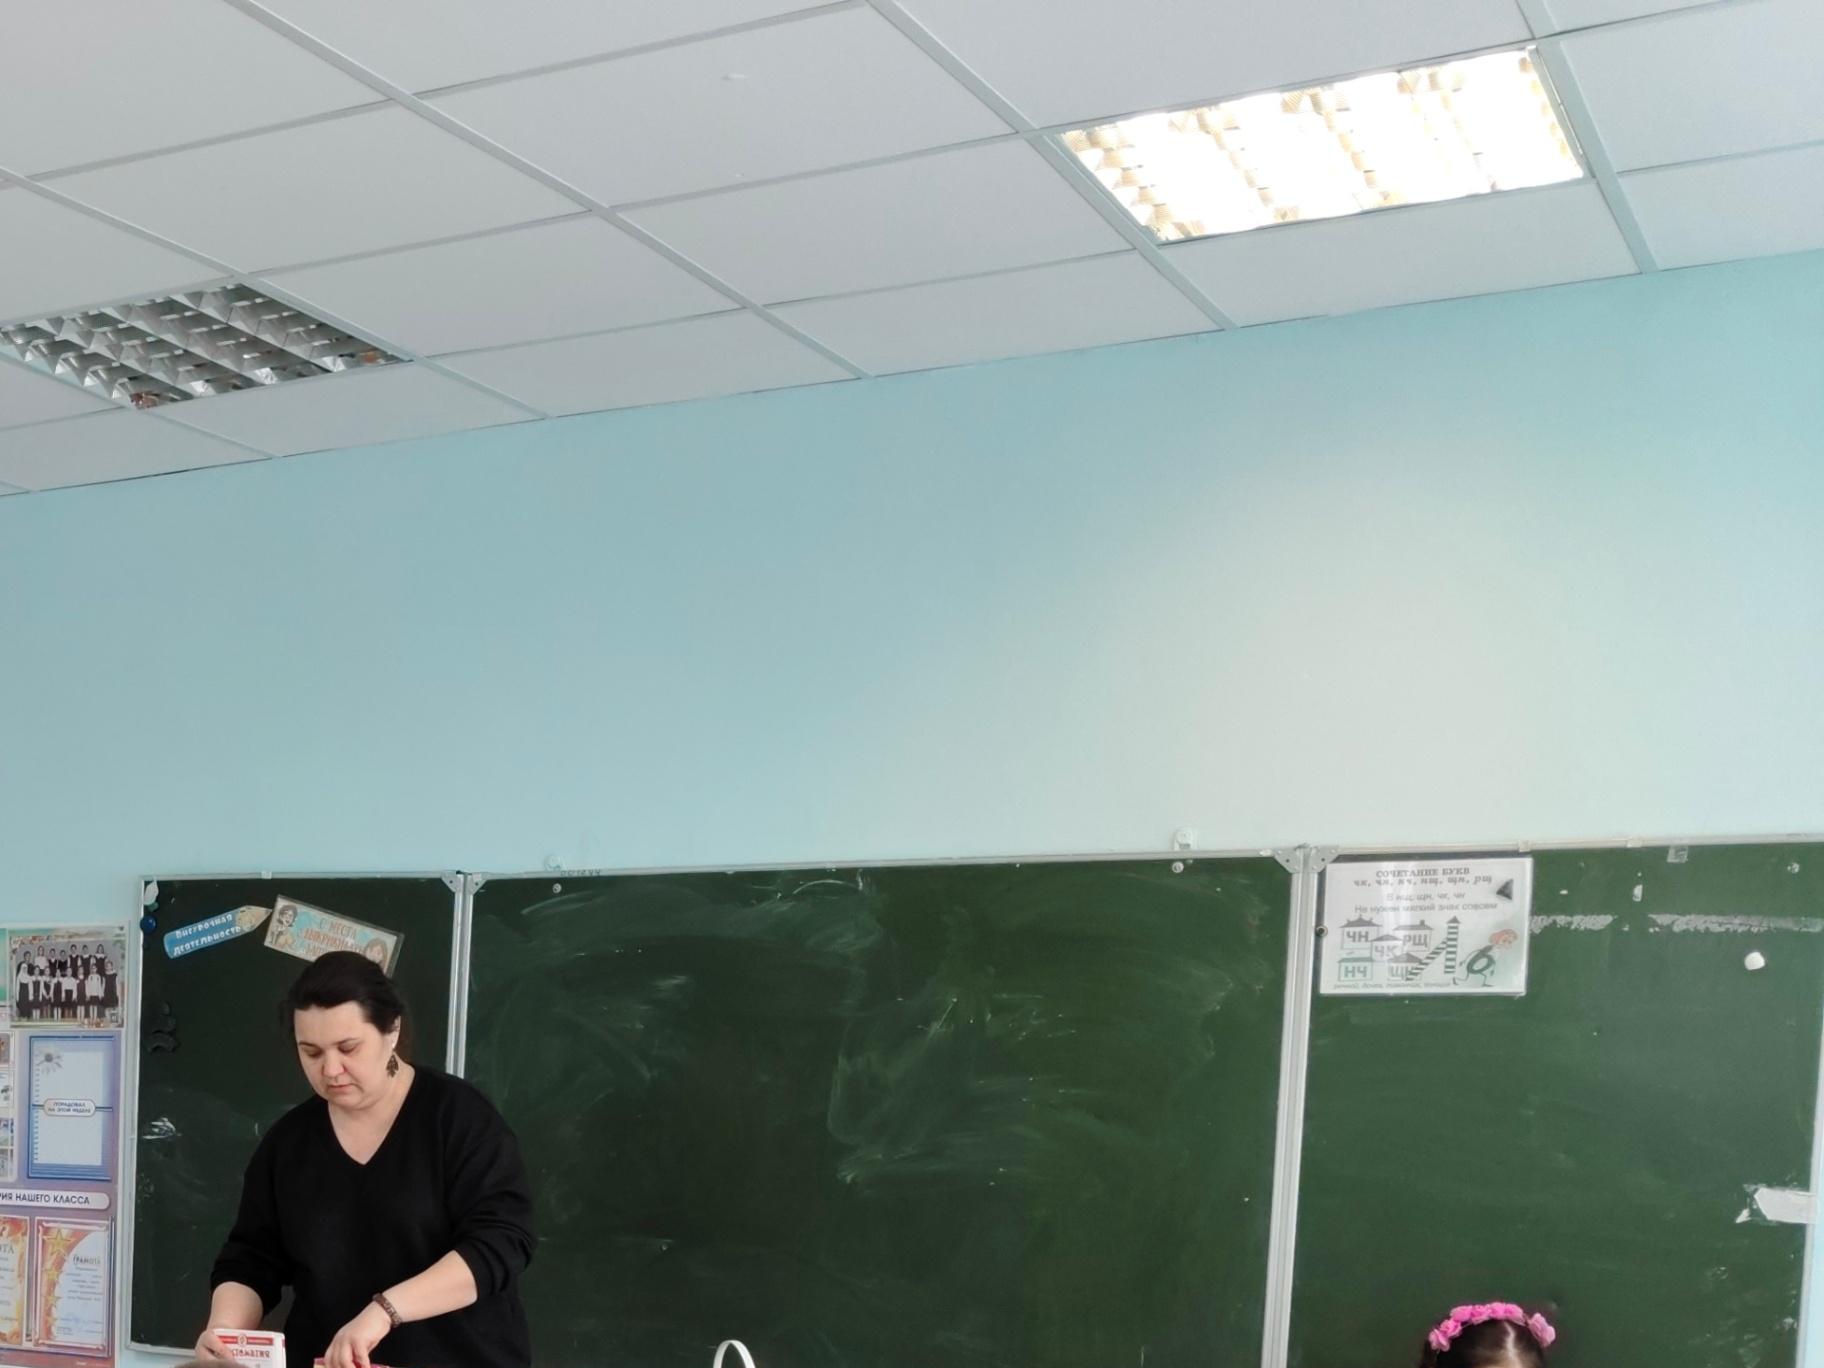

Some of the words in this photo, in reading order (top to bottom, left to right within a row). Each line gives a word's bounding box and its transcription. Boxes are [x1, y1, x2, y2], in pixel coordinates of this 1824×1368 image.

[1346, 931, 1368, 942] ЧН
[1344, 967, 1367, 978] НЧ
[15, 1193, 50, 1204] НАШЕГО
[53, 1194, 90, 1205] КЛАССА
